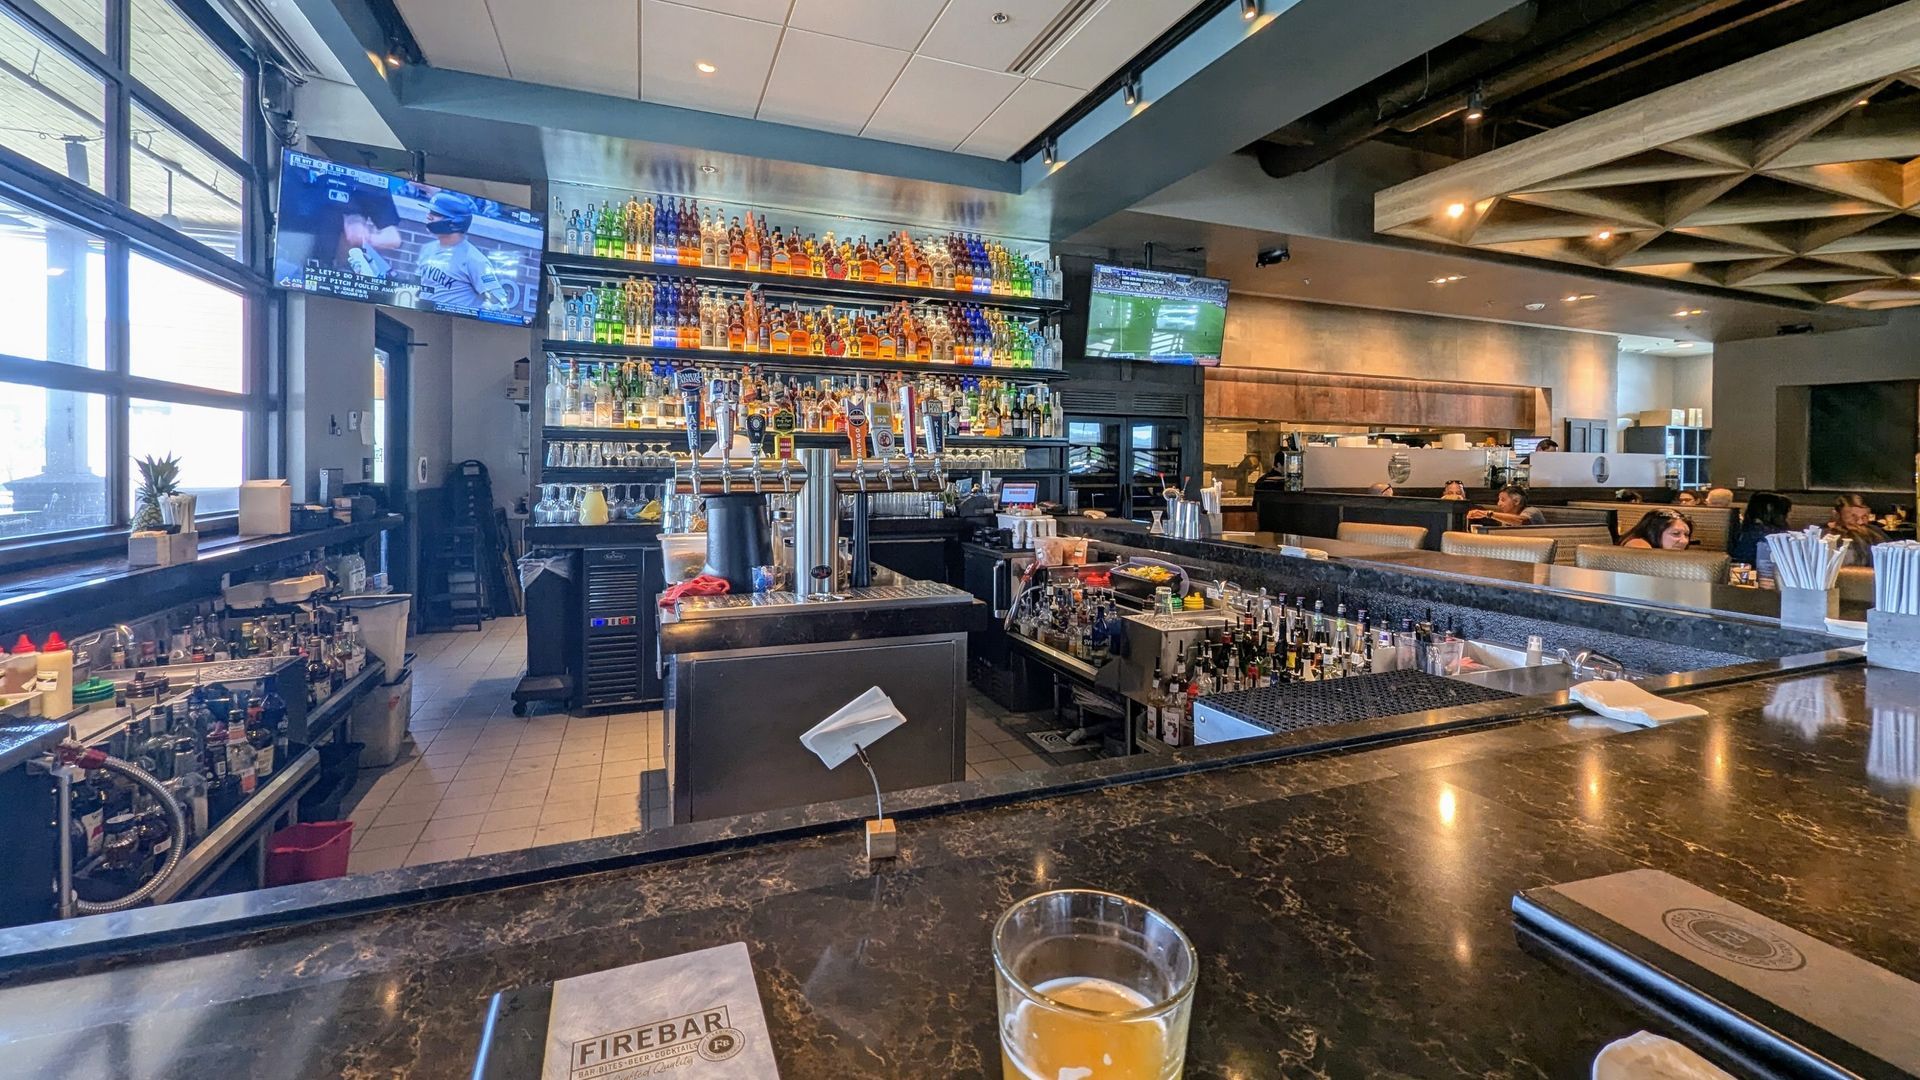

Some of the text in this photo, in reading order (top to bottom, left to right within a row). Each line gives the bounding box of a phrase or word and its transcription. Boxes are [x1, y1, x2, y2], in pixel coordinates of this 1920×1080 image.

[305, 273, 327, 282] FIRST
[329, 277, 352, 286] PITCH
[354, 282, 379, 291] FOULED
[319, 268, 341, 277] LET'S
[427, 265, 458, 290] YORK
[677, 371, 702, 381] SAMUEL
[679, 377, 701, 385] ADAMS
[687, 405, 698, 447] LAGER
[855, 427, 863, 458] PAPAGO
[579, 1011, 724, 1066] FIREBAR
[628, 1054, 651, 1065] BEER
[654, 1042, 698, 1059] COCKTAILS
[653, 1054, 694, 1075] Quality
